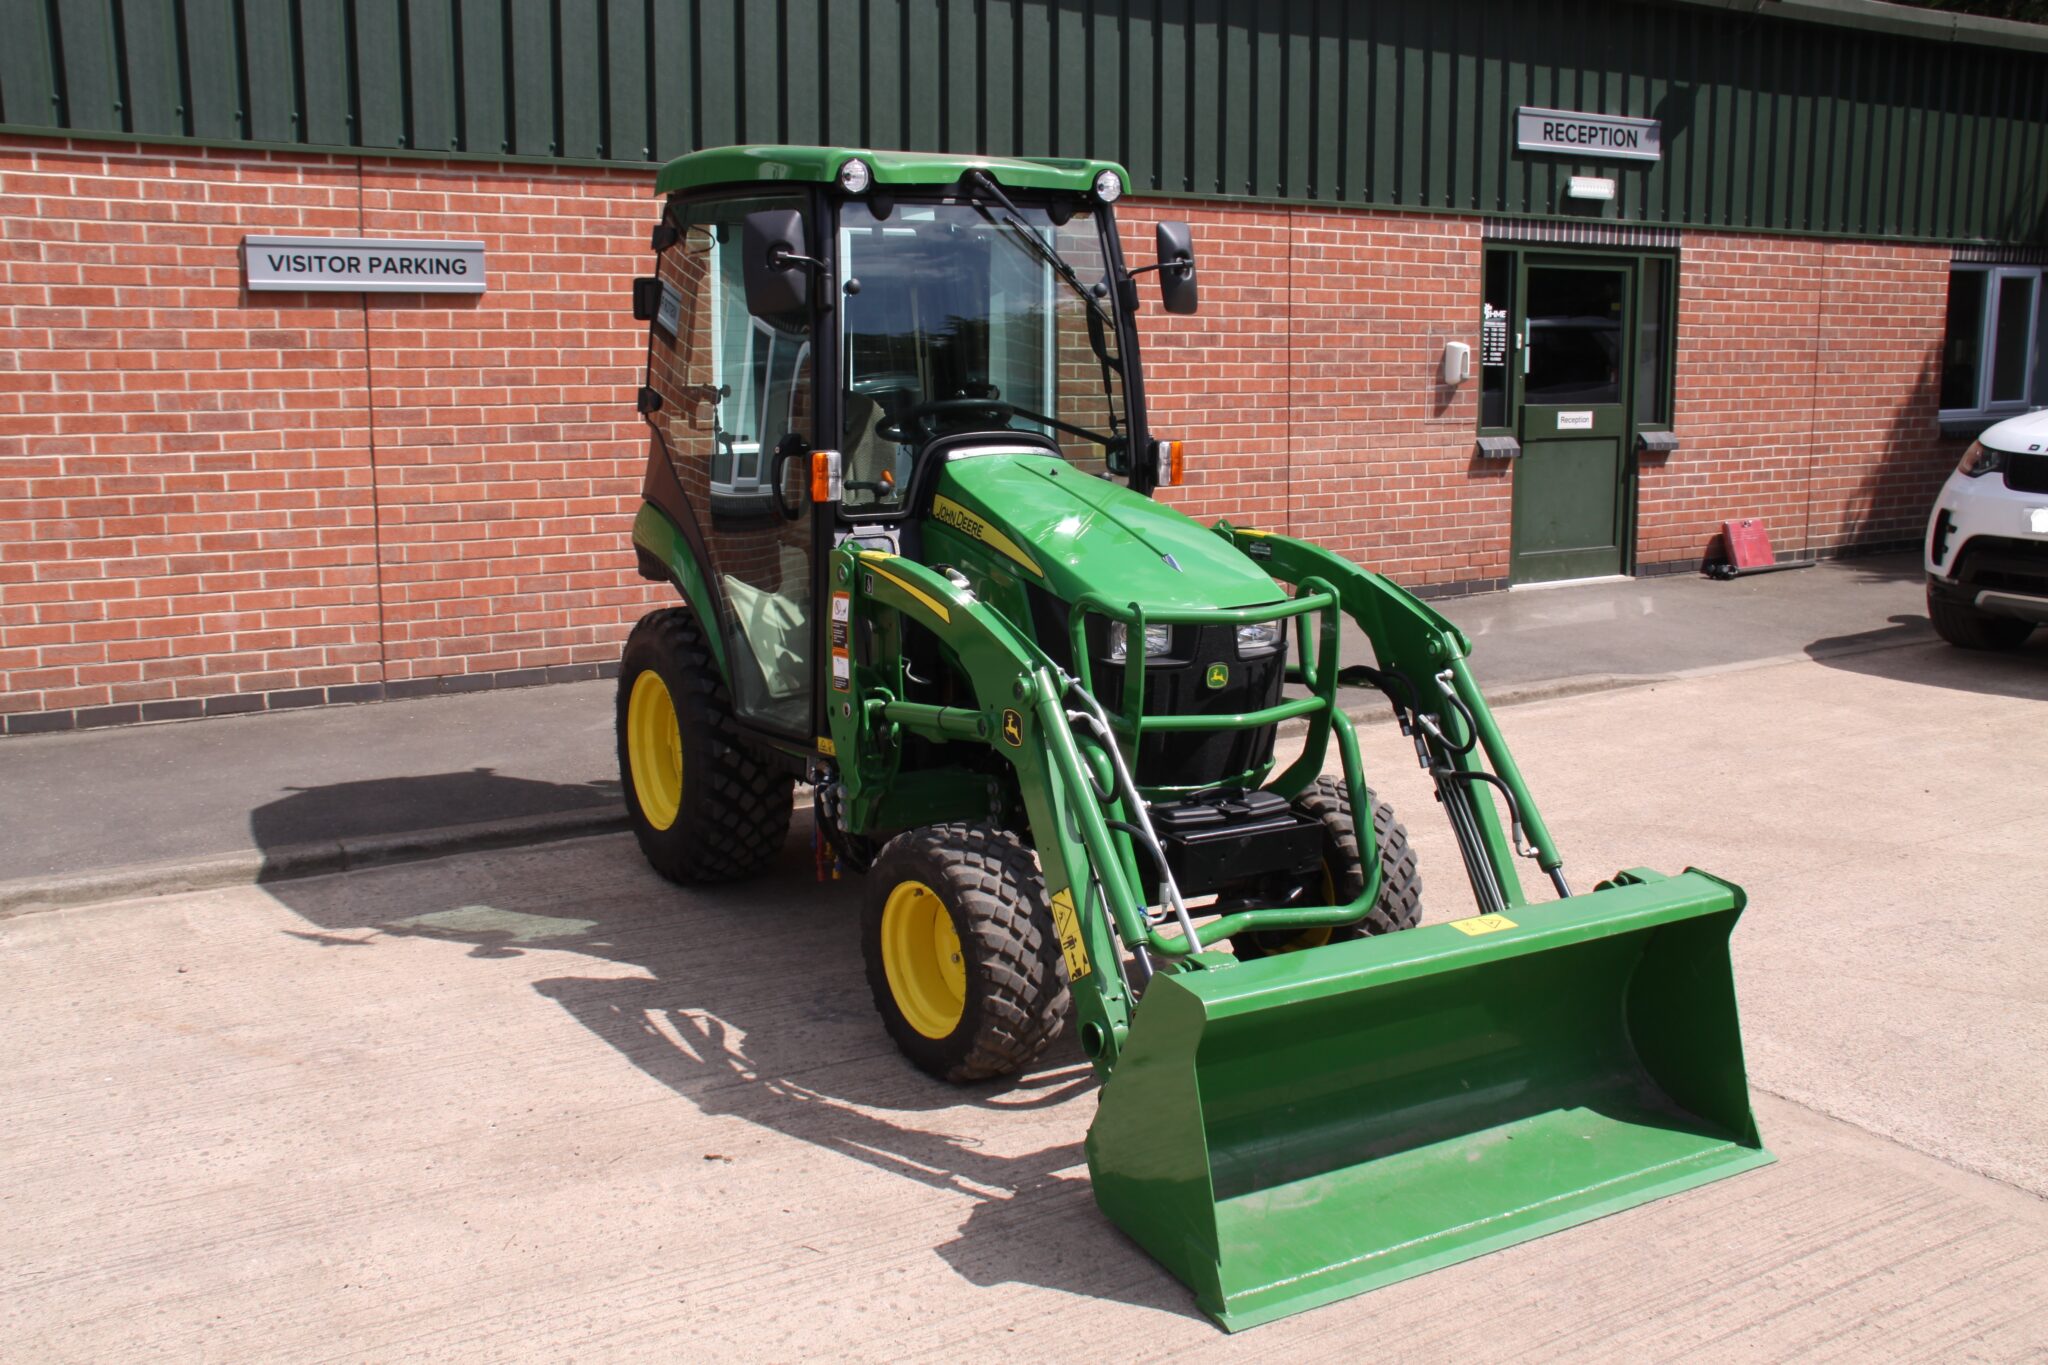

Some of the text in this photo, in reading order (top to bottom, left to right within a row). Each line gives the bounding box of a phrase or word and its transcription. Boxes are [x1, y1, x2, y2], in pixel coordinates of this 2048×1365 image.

[1543, 122, 1638, 148] RECEPTION
[267, 254, 467, 276] VISITOR PARKING
[1560, 416, 1590, 425] Reception
[936, 504, 984, 538] JOHN DEERE
